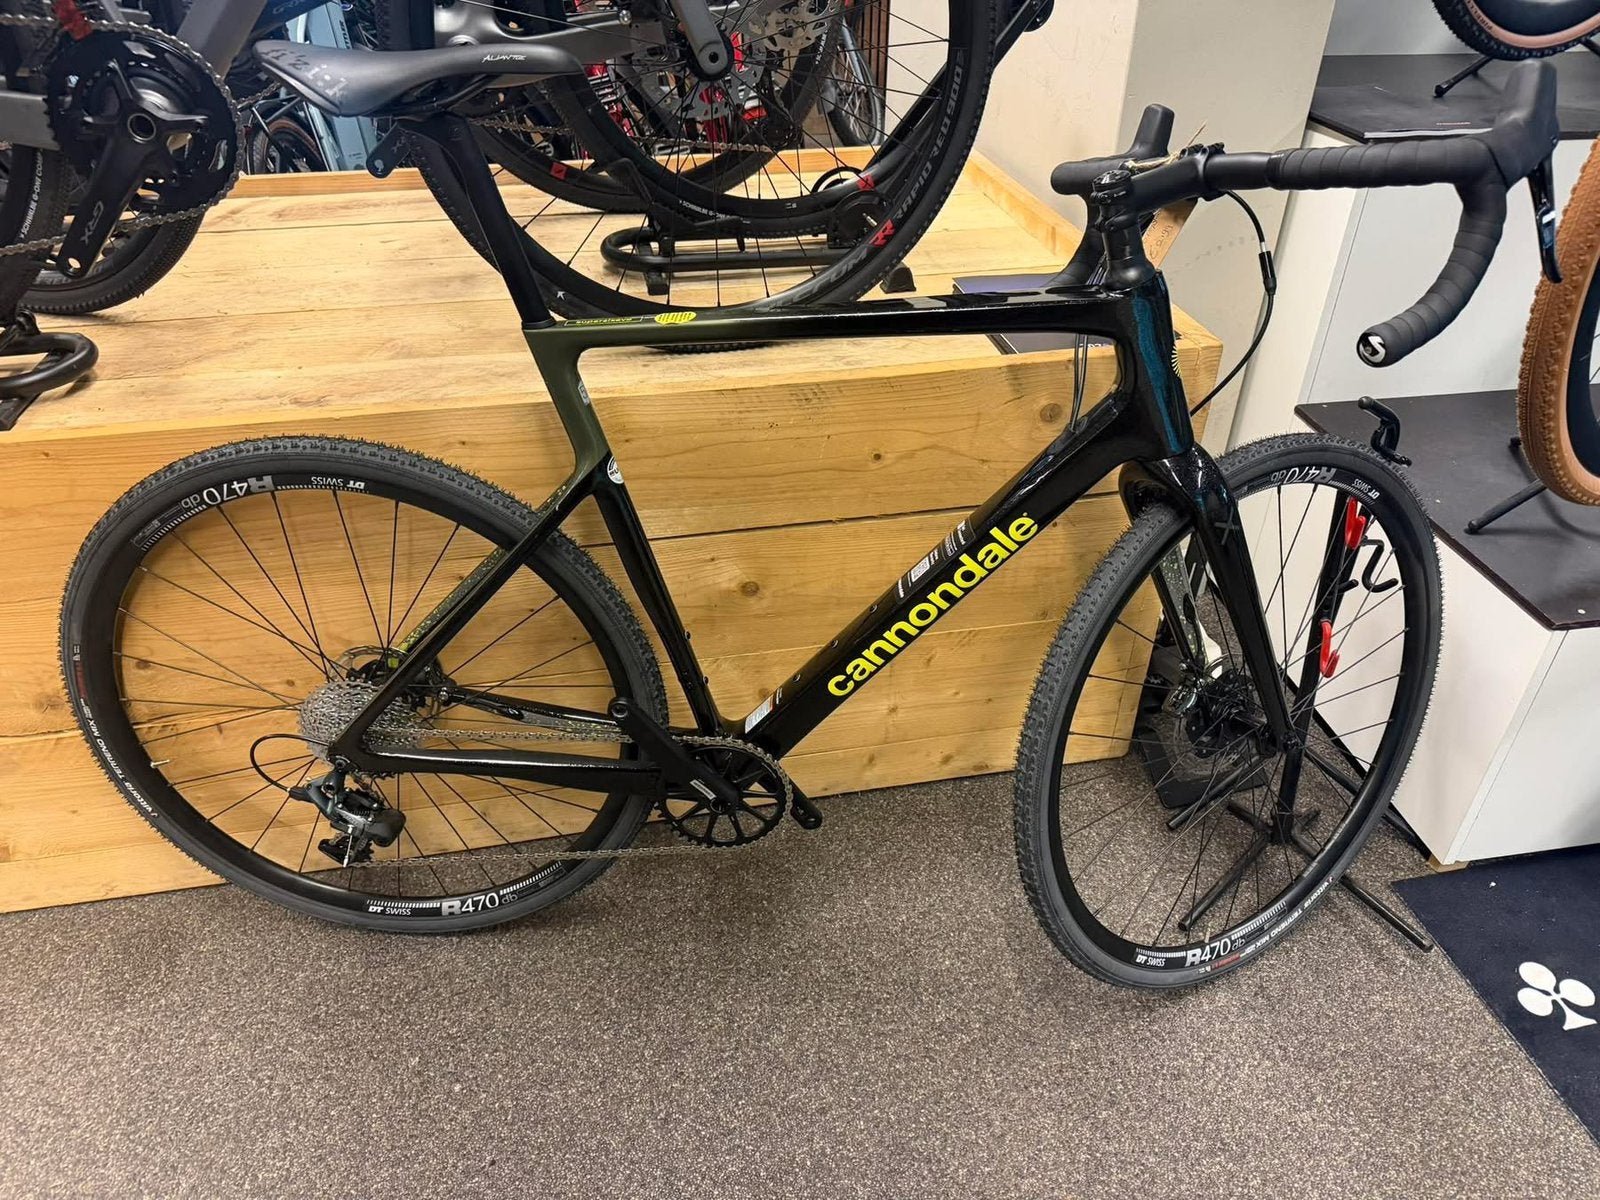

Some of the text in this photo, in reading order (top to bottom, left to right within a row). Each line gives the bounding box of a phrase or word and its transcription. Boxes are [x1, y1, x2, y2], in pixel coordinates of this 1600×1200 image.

[893, 161, 933, 219] RAPID
[946, 64, 963, 116] 900
[80, 200, 105, 245] GRX
[311, 476, 344, 487] SWISS
[346, 480, 366, 490] DT
[1351, 478, 1370, 493] SWISS
[180, 492, 201, 510] db
[1367, 490, 1381, 500] DT
[826, 514, 1039, 698] cannondale
[86, 717, 101, 738] MIX
[96, 737, 125, 781] TERRENO
[367, 892, 519, 917] DT SWISS R470 db
[1135, 954, 1147, 964] DT
[1146, 957, 1166, 968] SWISS
[1184, 938, 1231, 968] R470
[1231, 937, 1246, 951] db
